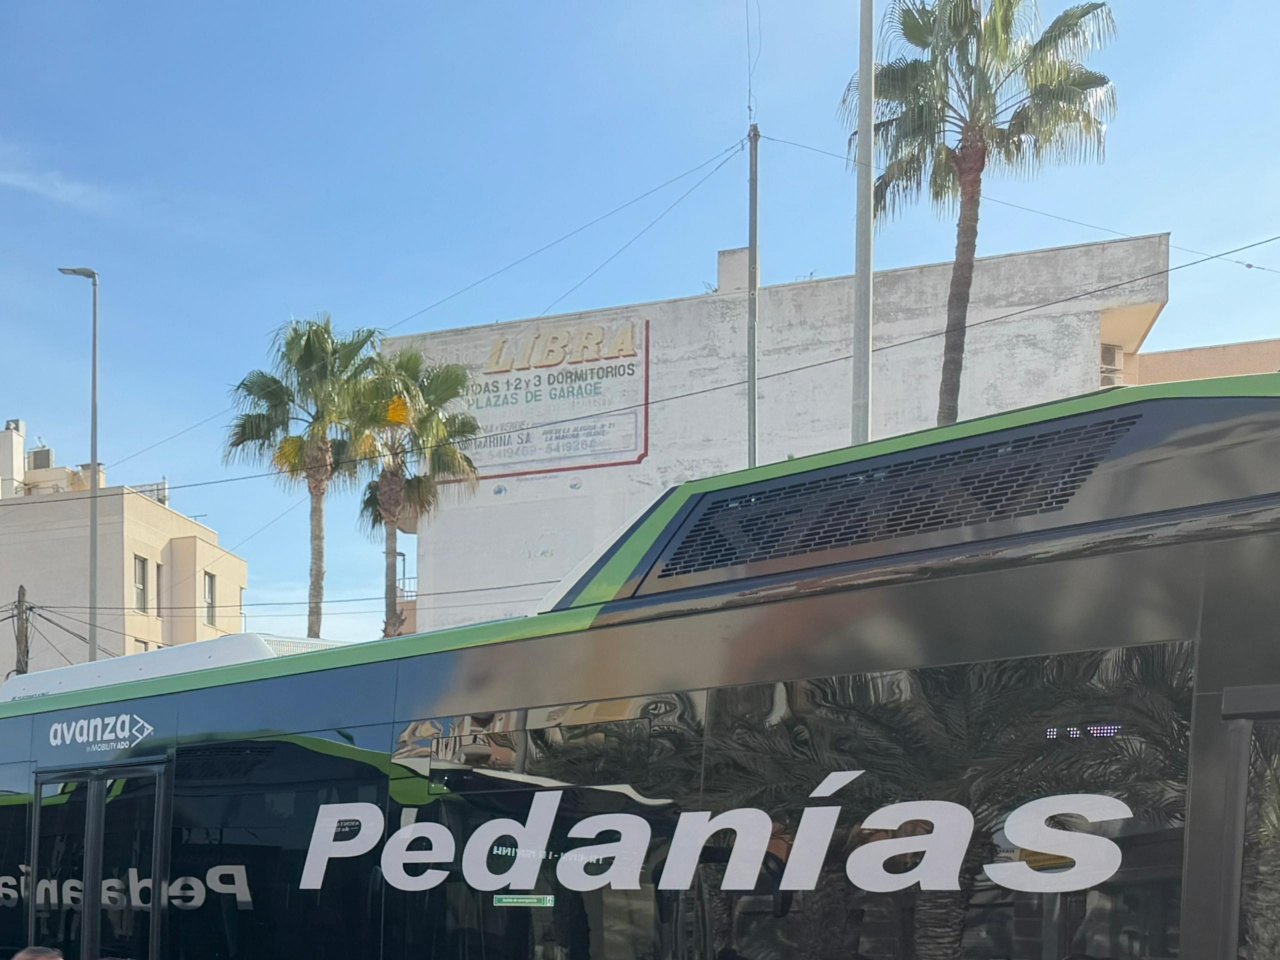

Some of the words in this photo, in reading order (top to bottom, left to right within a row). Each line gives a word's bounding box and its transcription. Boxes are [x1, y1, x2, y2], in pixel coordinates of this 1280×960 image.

[483, 320, 638, 374] LIBRA
[533, 374, 542, 387] 3
[547, 362, 636, 386] DORMITORIOS
[467, 392, 519, 411] PLAZAS
[525, 389, 542, 404] DE
[549, 381, 603, 399] GARAGE
[49, 713, 131, 747] avanza
[90, 742, 117, 752] MOBILITY
[117, 741, 130, 749] ADO
[299, 769, 1134, 892] Pedanías
